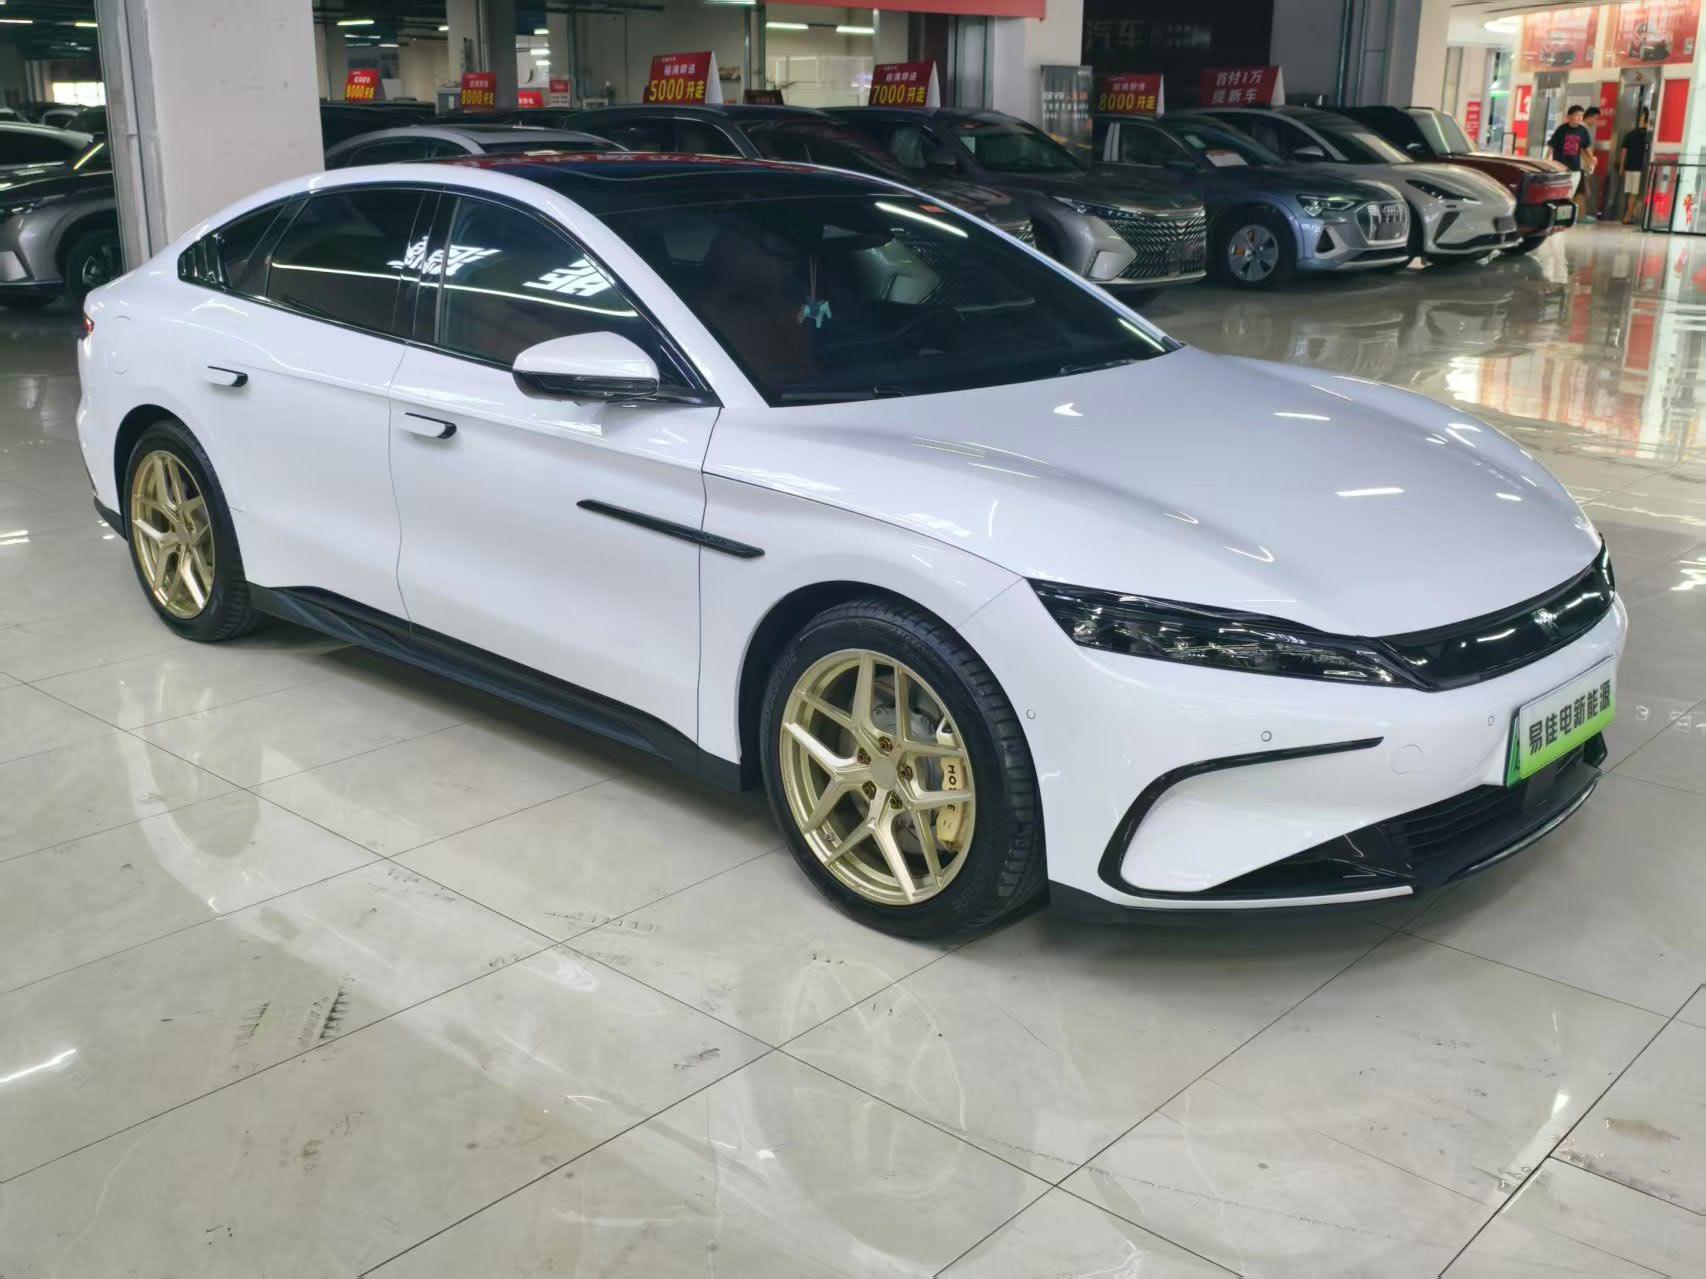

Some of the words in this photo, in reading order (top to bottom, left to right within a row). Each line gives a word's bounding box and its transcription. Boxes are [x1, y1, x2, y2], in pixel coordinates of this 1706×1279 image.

[1216, 70, 1264, 87] 首付1万
[1528, 679, 1611, 755] 易佳电新能源
